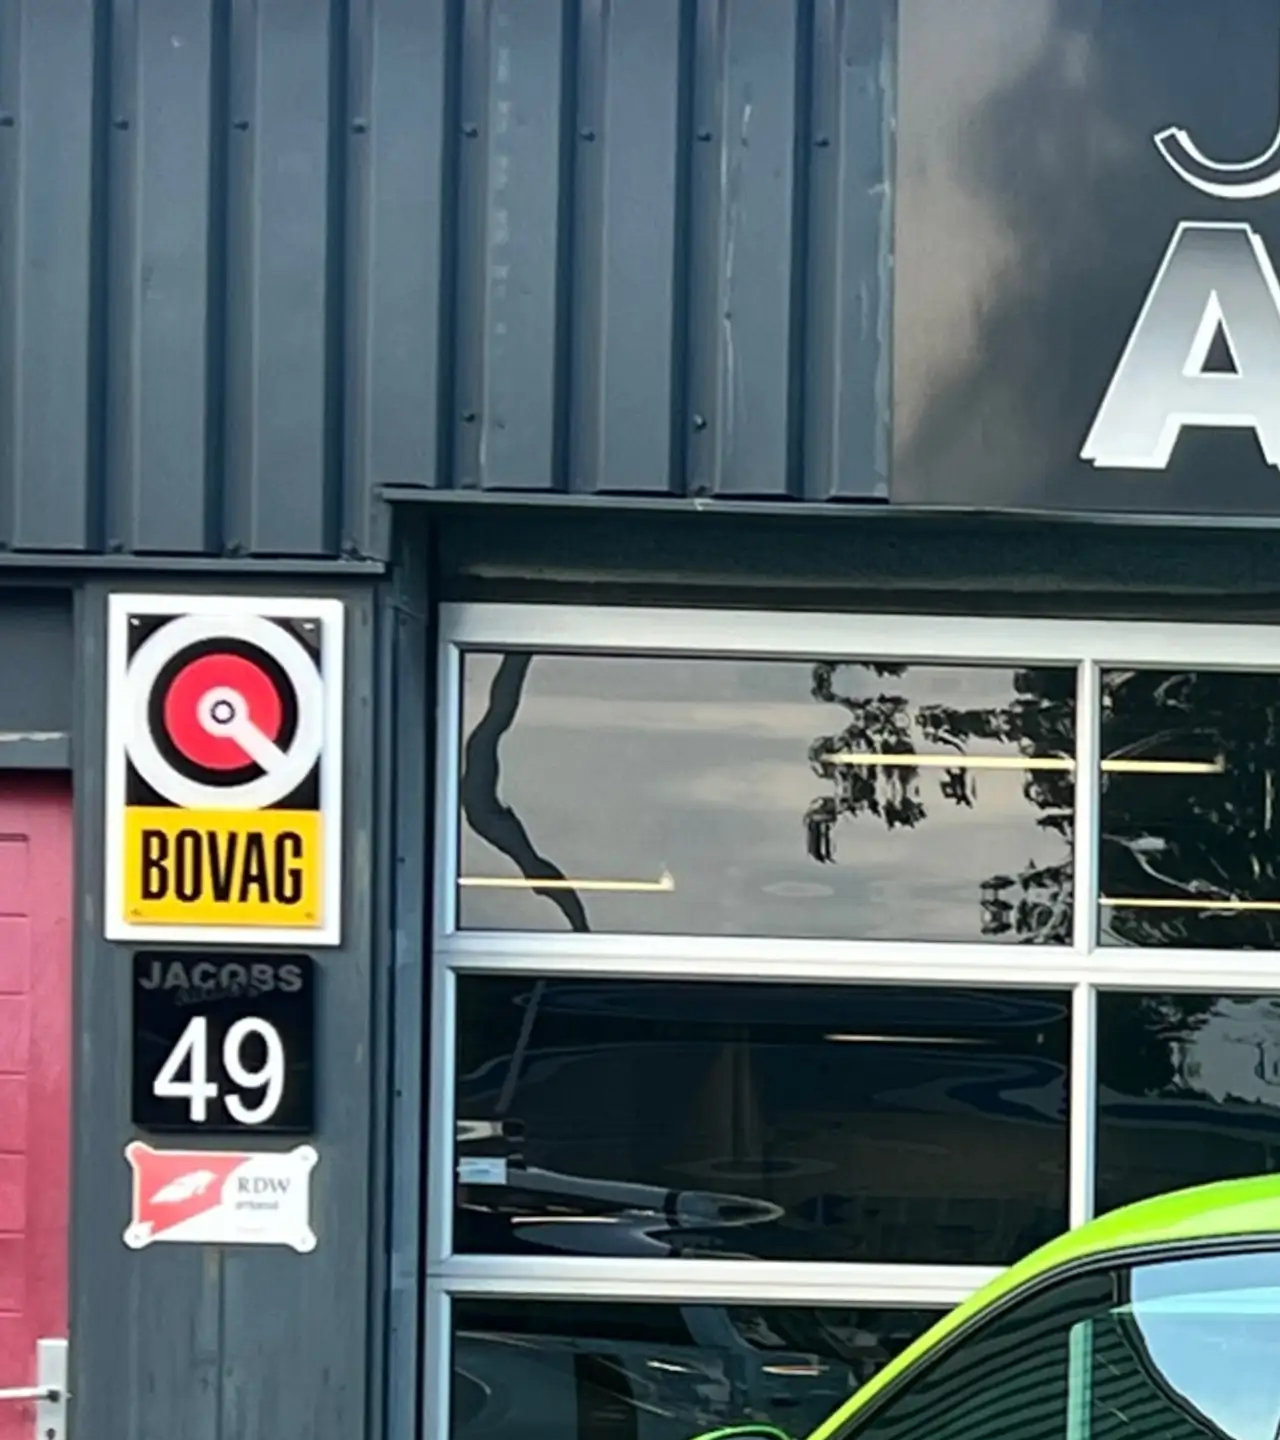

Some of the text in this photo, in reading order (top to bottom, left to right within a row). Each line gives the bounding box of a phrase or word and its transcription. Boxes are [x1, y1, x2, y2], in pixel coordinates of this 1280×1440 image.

[141, 829, 303, 905] BOVAG
[138, 961, 303, 992] JACOBS
[153, 1016, 285, 1124] 49
[237, 1177, 291, 1194] RDW
